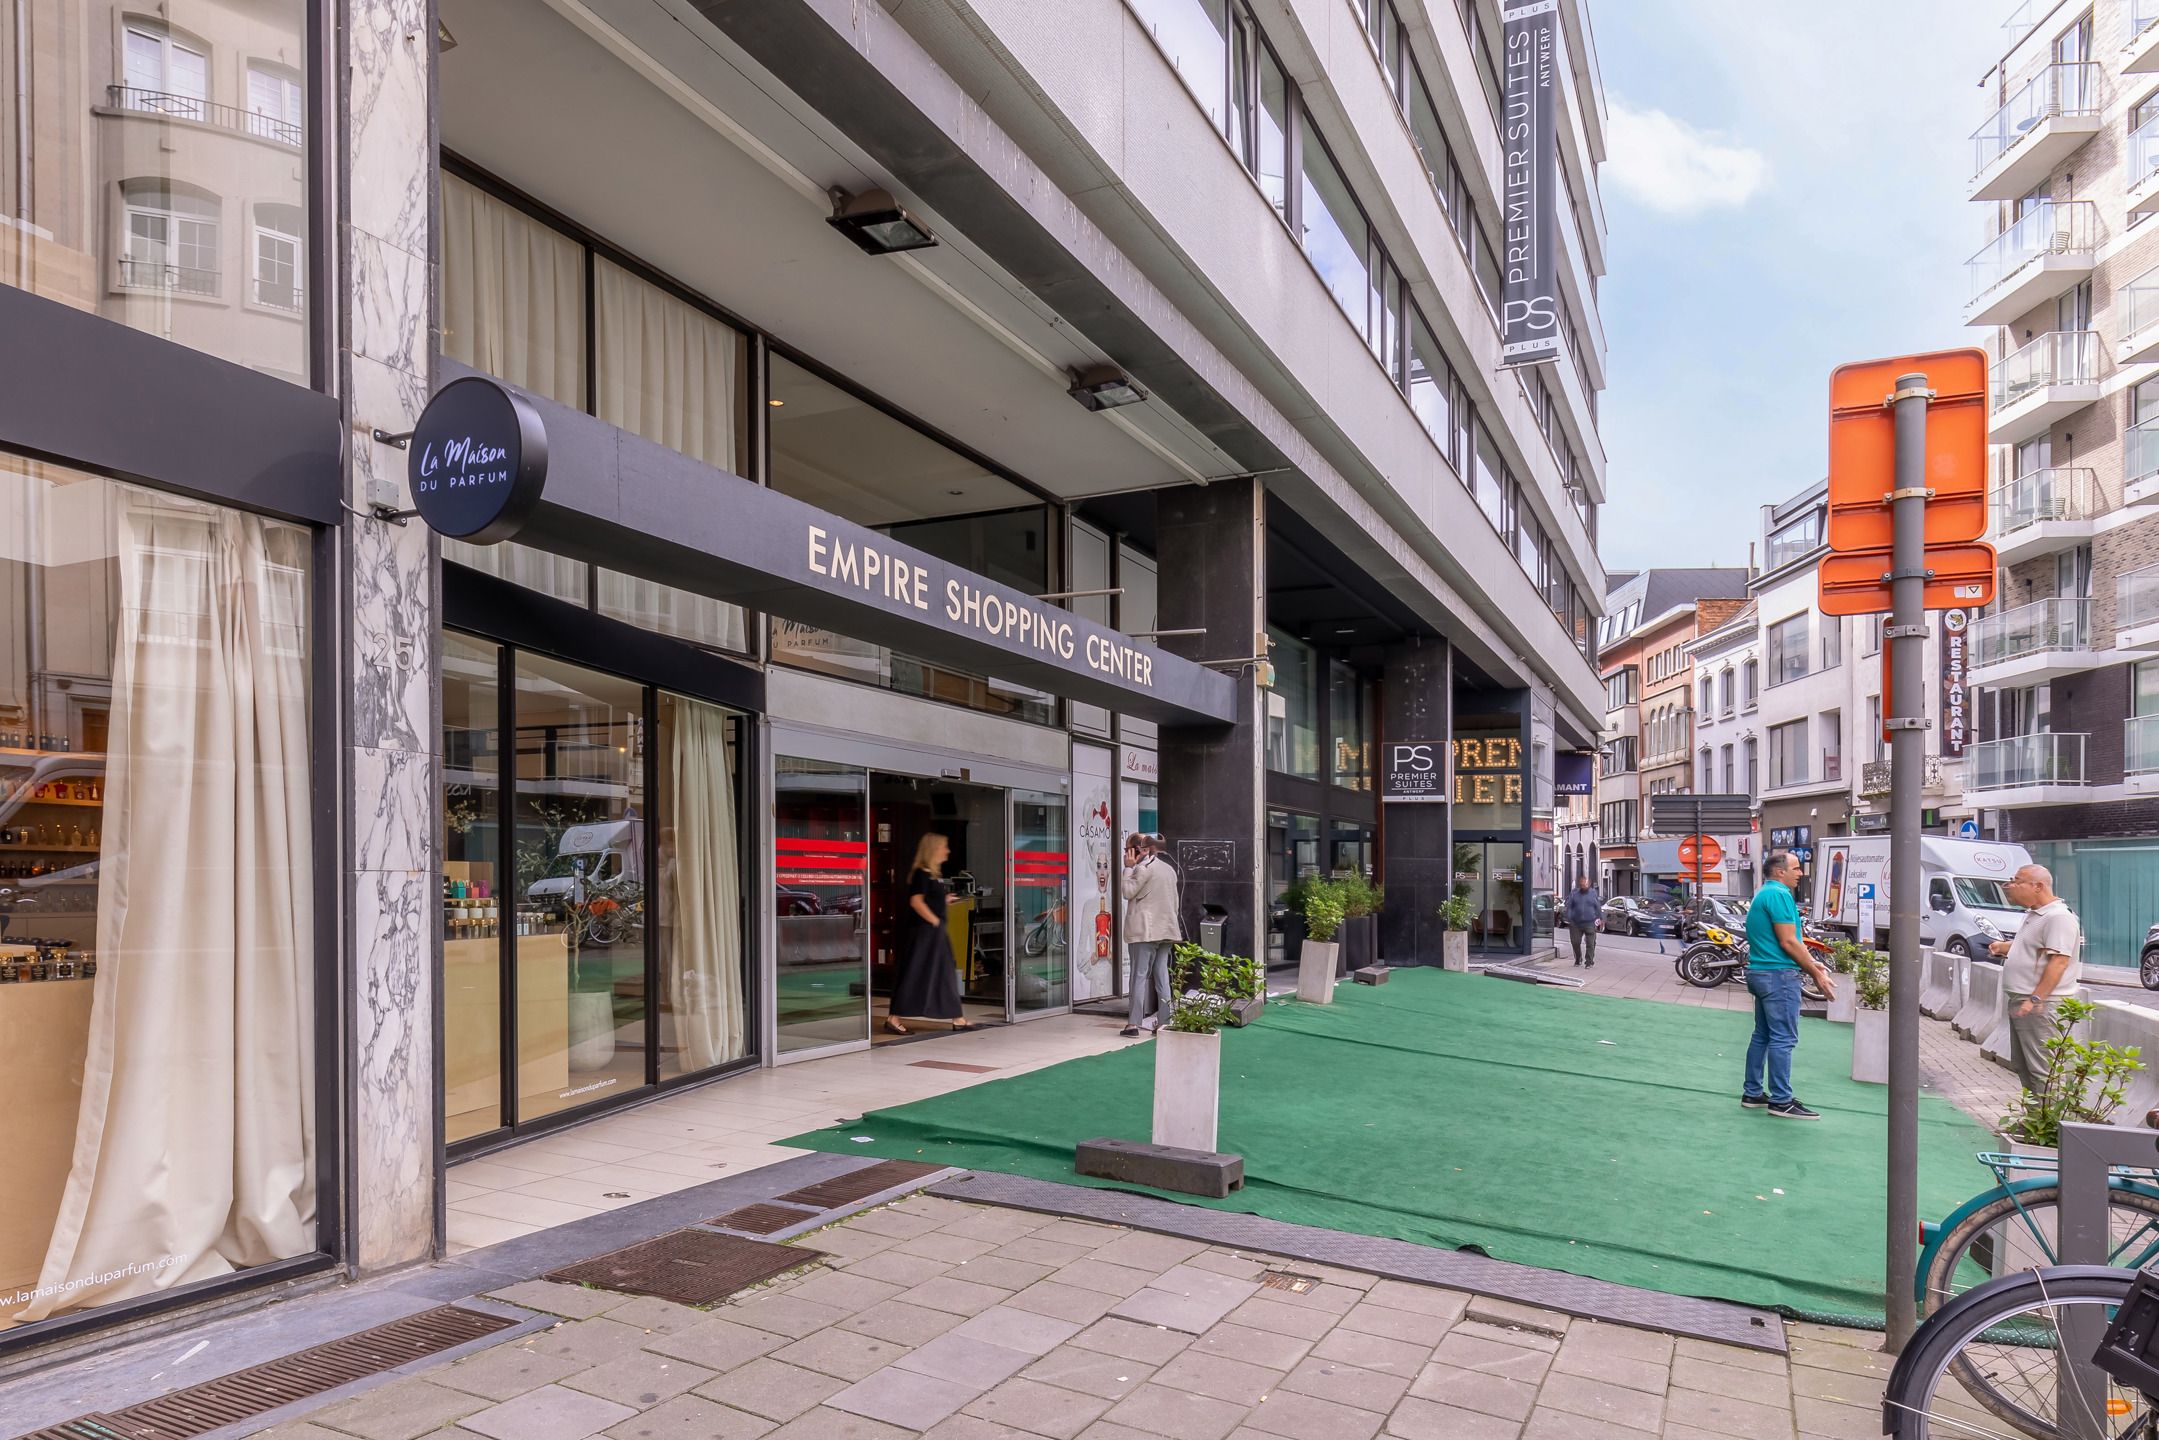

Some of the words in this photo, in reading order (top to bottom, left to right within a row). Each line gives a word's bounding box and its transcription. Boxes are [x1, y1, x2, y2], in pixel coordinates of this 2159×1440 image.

[1509, 3, 1550, 18] PLUS
[1540, 27, 1550, 87] ANTWERP
[1508, 31, 1529, 141] SUITES
[1508, 148, 1529, 284] PREMIER
[1504, 296, 1555, 335] PS
[1509, 340, 1550, 352] PLUS
[421, 442, 438, 477] La
[444, 437, 507, 474] Maison
[420, 480, 437, 491] DU
[450, 470, 507, 488] PARFUM
[808, 525, 929, 610] EMPIRE
[945, 579, 1075, 660] SHOPPING
[1087, 634, 1153, 687] CENTER
[373, 632, 414, 671] 25
[787, 638, 829, 648] PARFUM
[1949, 636, 1964, 752] RESTAURANT
[1394, 745, 1433, 772] PS
[1390, 772, 1437, 780] PREMIER
[1395, 780, 1433, 788] SUITES
[1554, 783, 1588, 791] MANT
[1859, 885, 1870, 897] P
